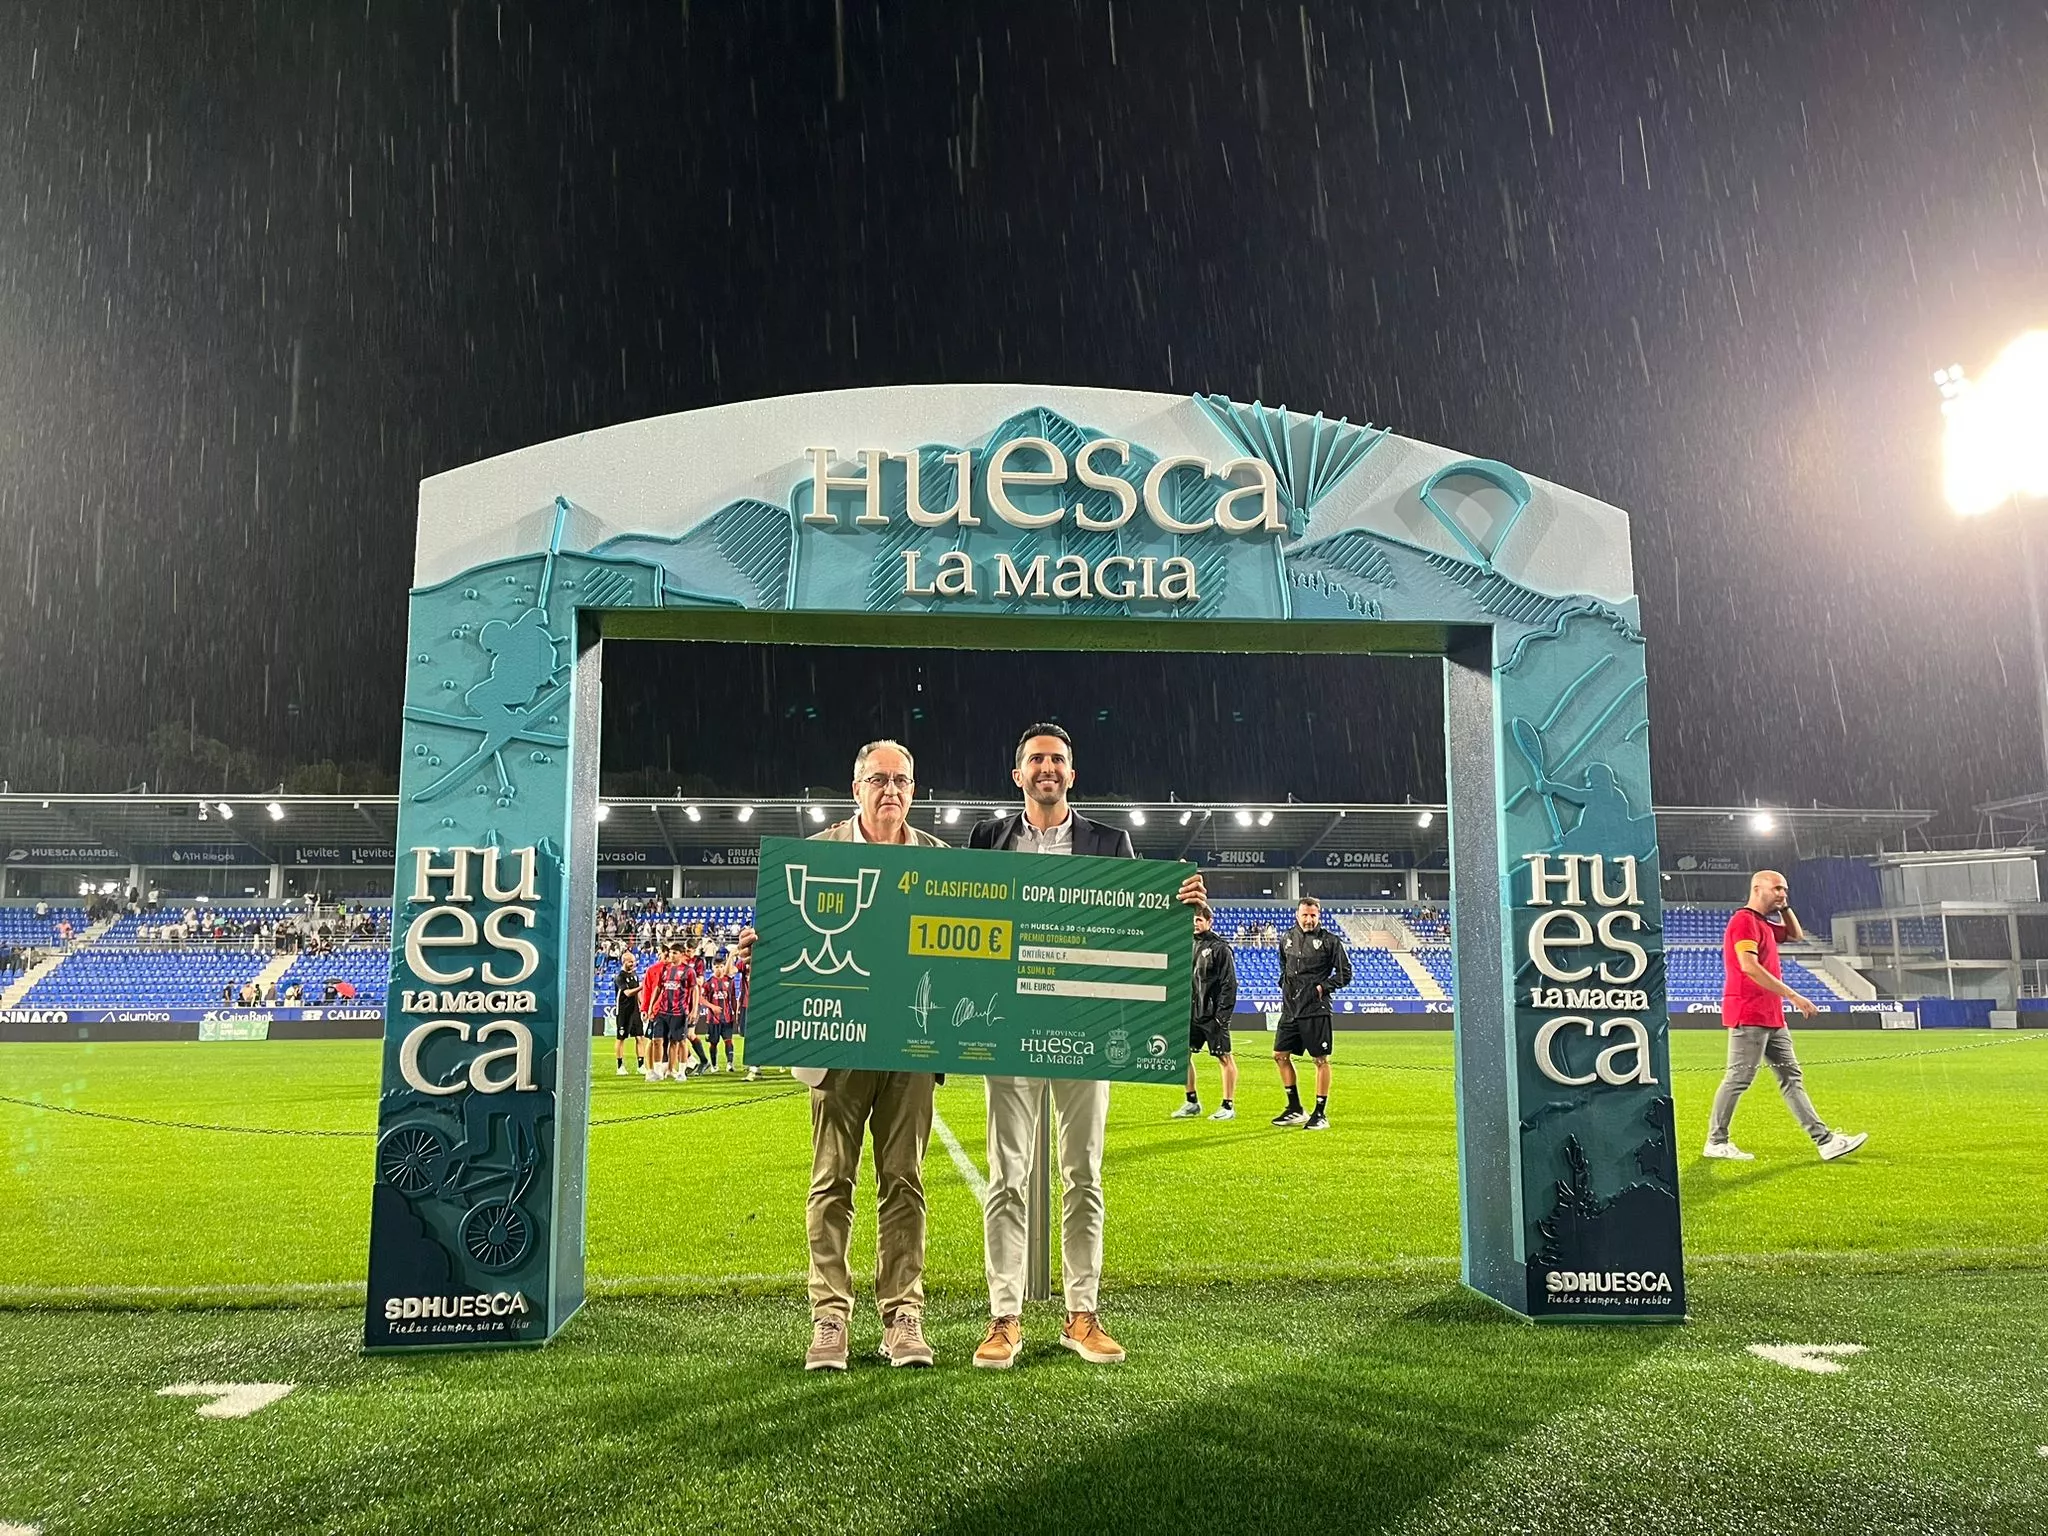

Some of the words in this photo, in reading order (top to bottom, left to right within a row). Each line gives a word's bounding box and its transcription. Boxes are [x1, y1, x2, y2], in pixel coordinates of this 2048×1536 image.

[800, 437, 1287, 535] Huesca
[31, 848, 78, 857] HUESCA
[728, 848, 760, 856] GRUAS
[1344, 852, 1389, 862] DOMEC
[925, 880, 1008, 900] CLASIFICADO
[818, 892, 844, 914] DPH
[1022, 885, 1056, 903] COPA
[1059, 887, 1134, 908] DIPUTACIÓN
[1138, 892, 1170, 910] 2024
[1030, 923, 1060, 932] HUESCA
[1086, 927, 1116, 935] AGOSTO
[917, 922, 982, 952] 1.000
[988, 926, 1002, 954] €
[1020, 932, 1044, 943] PREMIO
[1046, 934, 1081, 944] OTORGADO
[1082, 936, 1088, 945] A
[1022, 949, 1054, 960] ONTIÑENA
[1056, 951, 1068, 961] C.F.
[1018, 966, 1026, 974] LA
[1027, 966, 1046, 975] SUMA
[1046, 967, 1056, 976] DE
[1020, 982, 1032, 991] MIL
[1034, 982, 1056, 992] EUROS
[802, 998, 842, 1018] COPA
[1850, 1002, 1894, 1013] podoactiva
[119, 1012, 170, 1022] alumbra
[219, 1010, 274, 1022] CaixaBank
[327, 1009, 382, 1020] CALLIZO
[774, 1019, 867, 1042] DIPUTACIÓN
[1020, 1037, 1096, 1055] Huesca
[1136, 1057, 1176, 1066] DIPUTACIÓN
[1546, 1271, 1673, 1293] SDHUESCA
[384, 1291, 530, 1320] SDHUESCA
[1548, 1294, 1580, 1304] Fieles
[1625, 1296, 1639, 1305] sin
[1641, 1295, 1672, 1305] reblar
[388, 1321, 428, 1334] Fieles
[476, 1320, 490, 1332] sin
